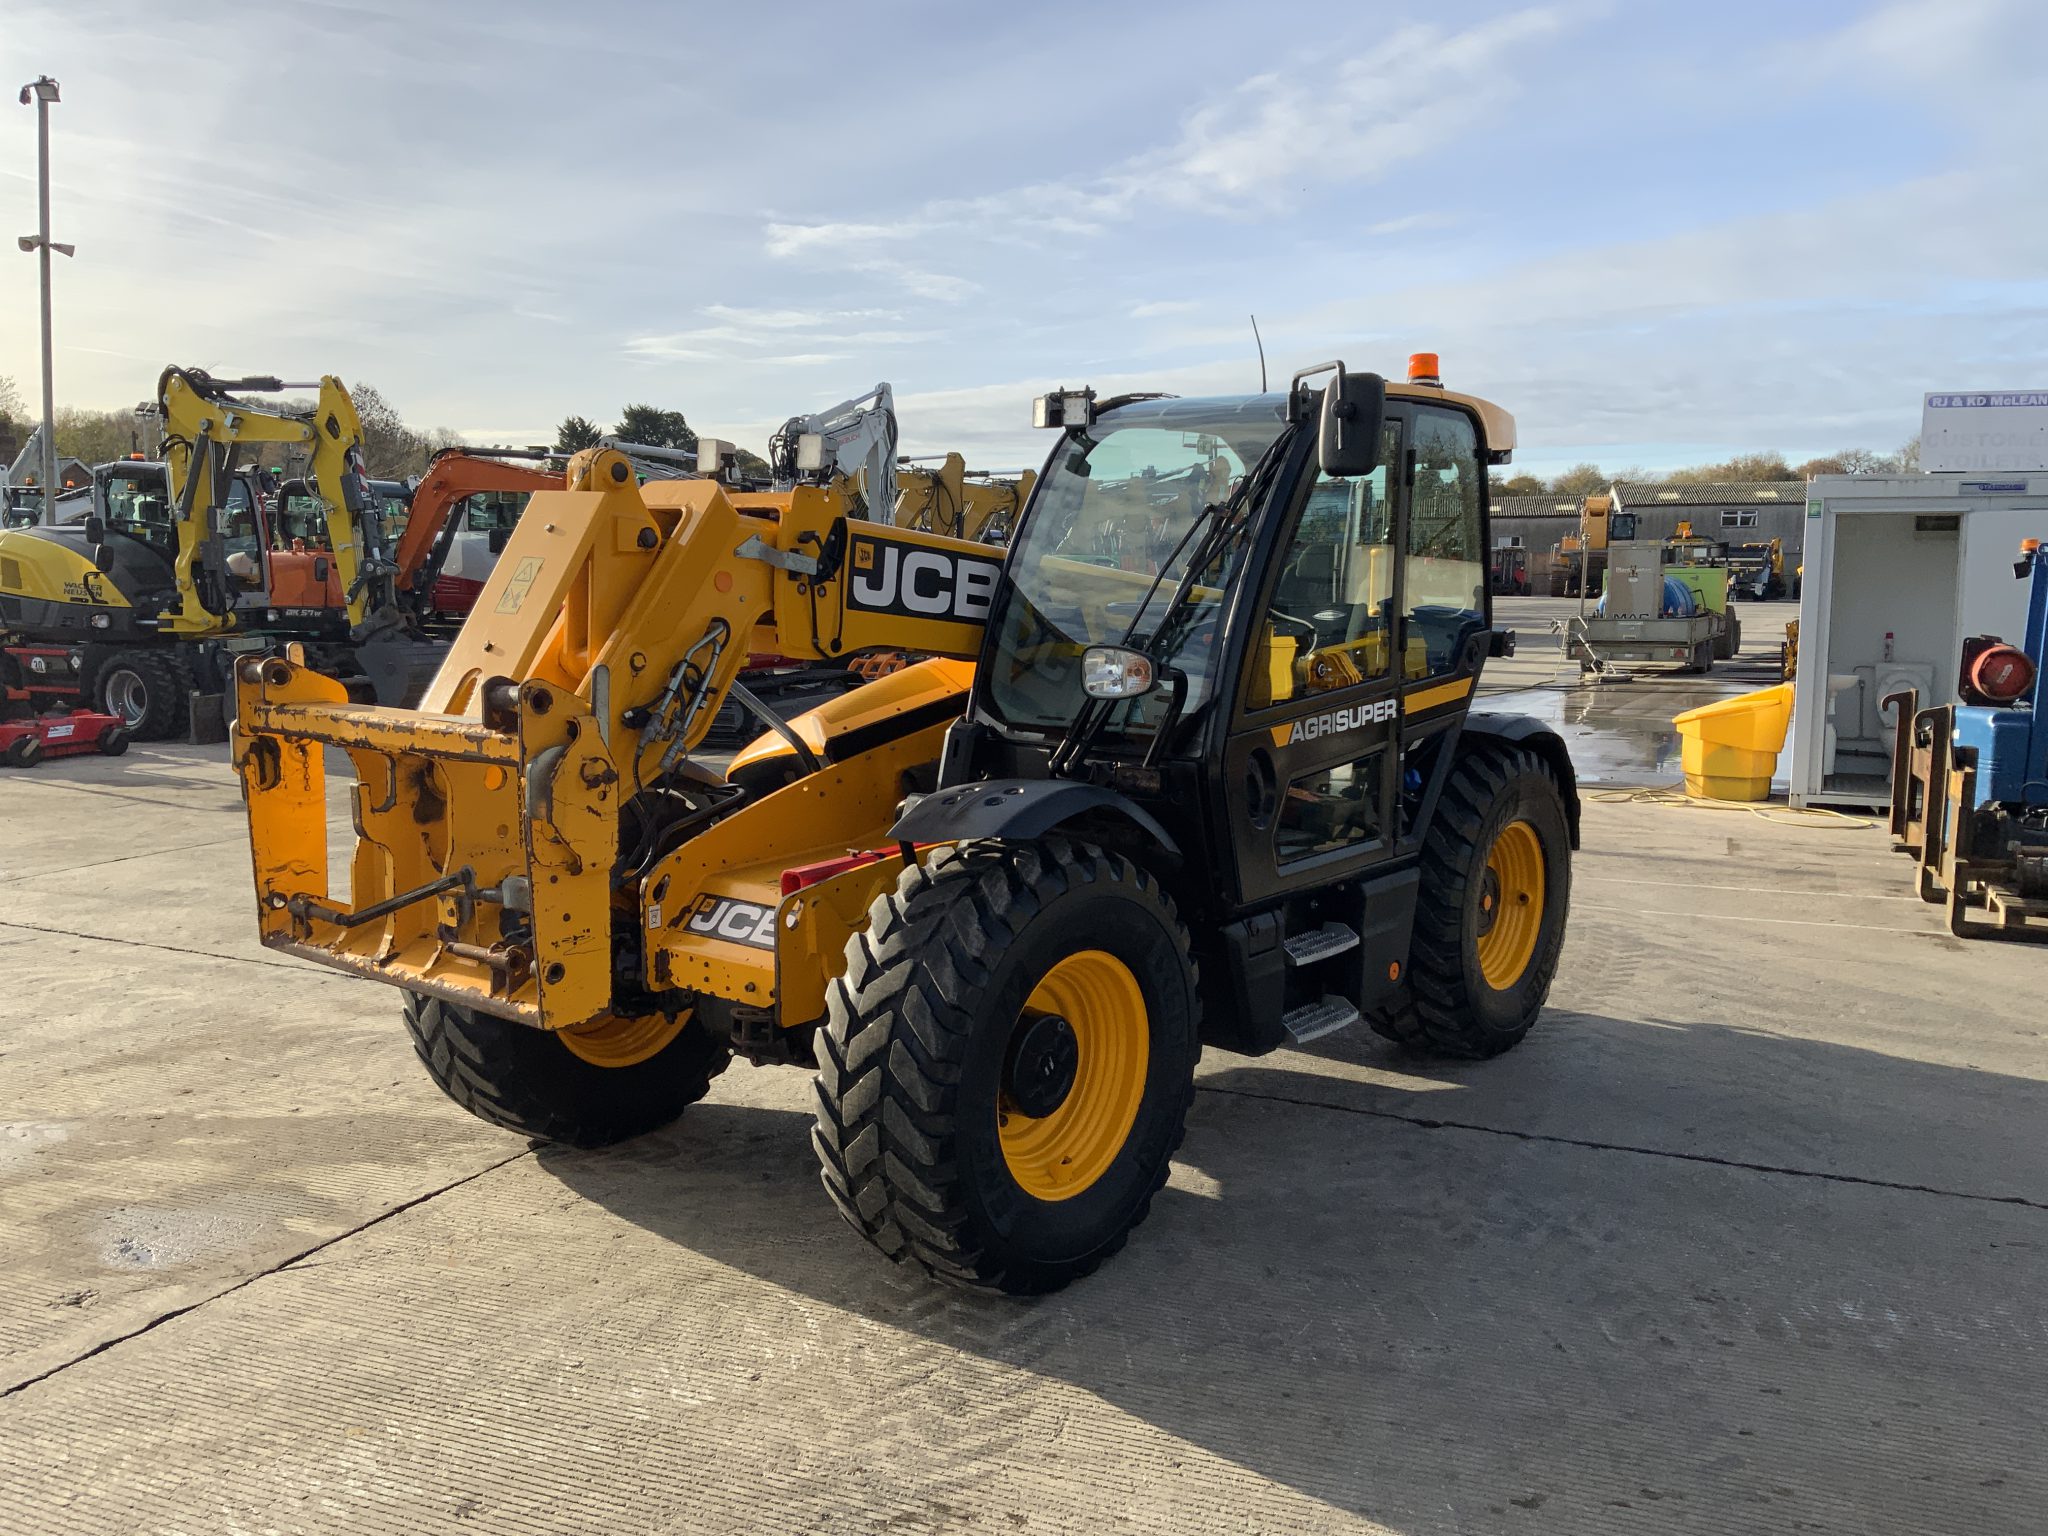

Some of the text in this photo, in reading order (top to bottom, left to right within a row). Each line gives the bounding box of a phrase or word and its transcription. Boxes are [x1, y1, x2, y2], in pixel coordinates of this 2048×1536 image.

[1932, 394, 2048, 407] RJ & KD McLEAN
[1925, 432, 2048, 449] CUSTOME
[853, 546, 1001, 619] JCB
[1289, 698, 1397, 745] AGRISUPER
